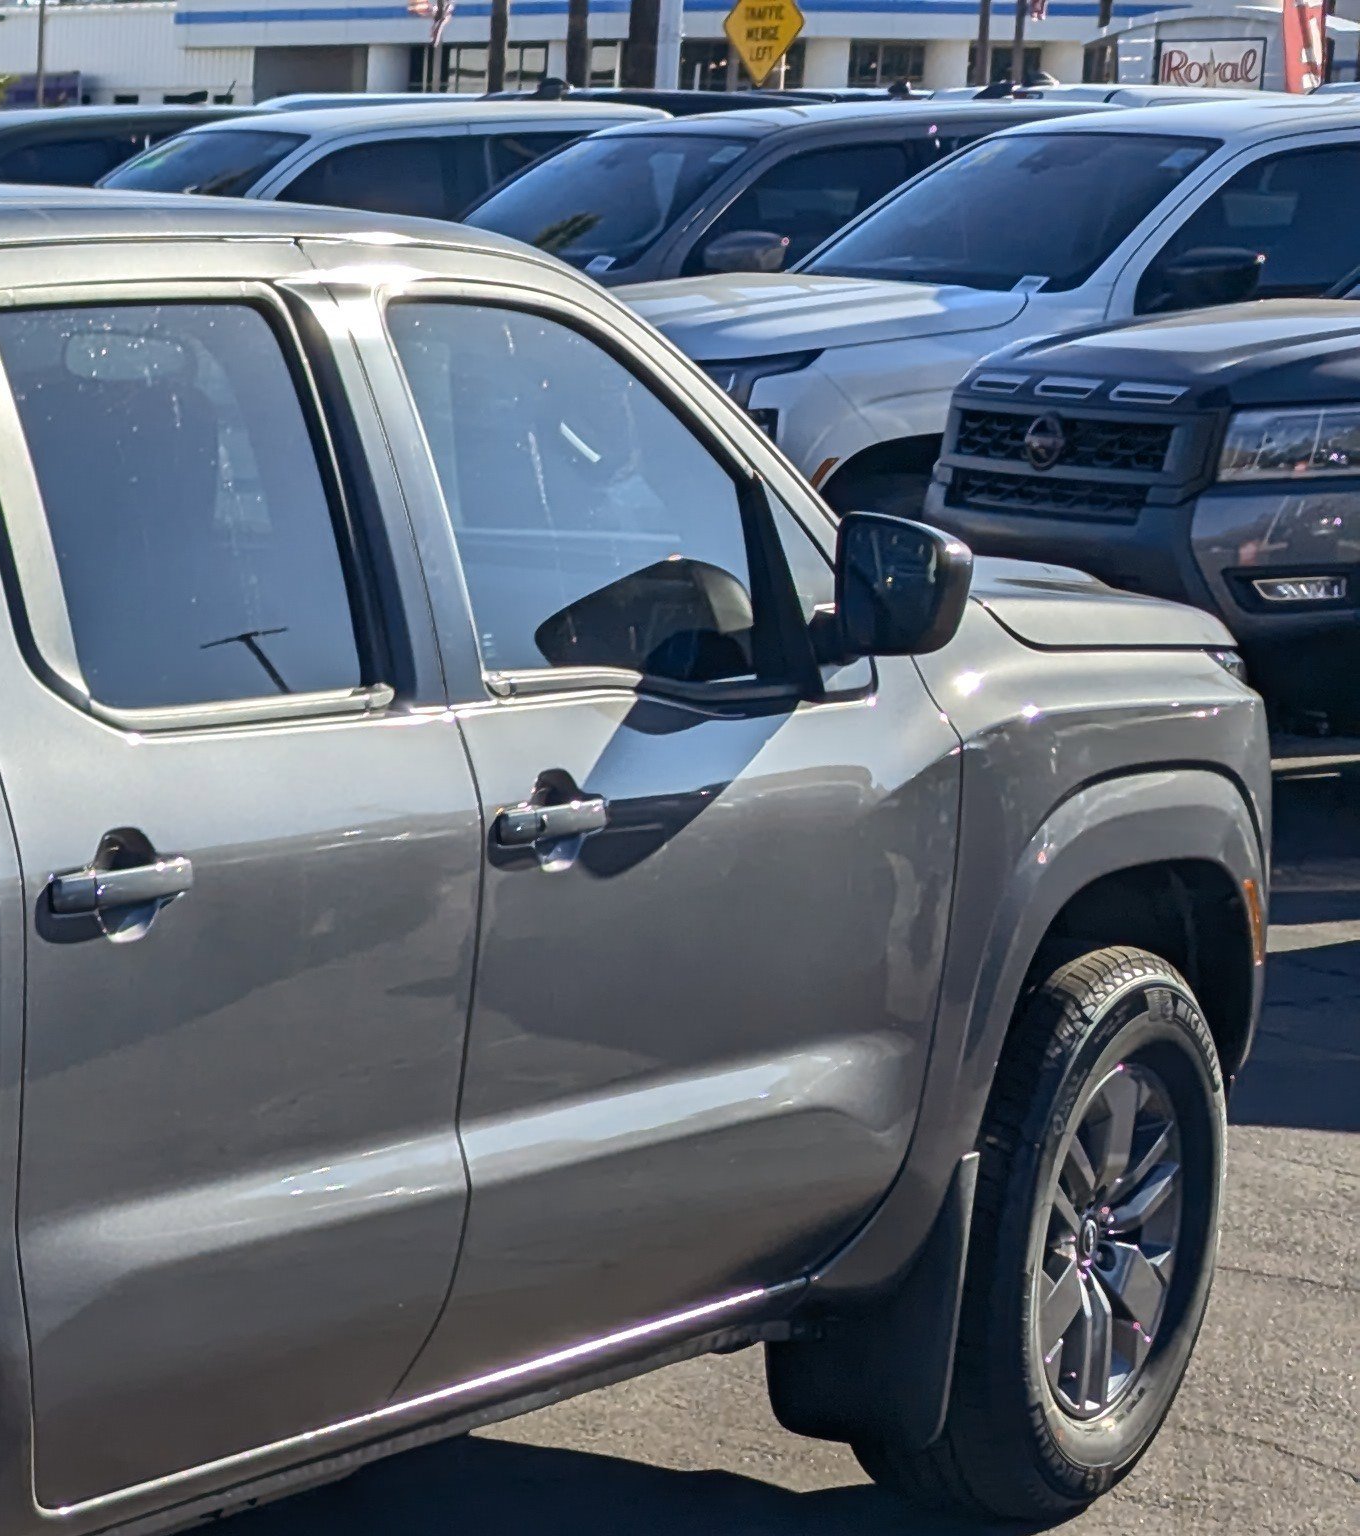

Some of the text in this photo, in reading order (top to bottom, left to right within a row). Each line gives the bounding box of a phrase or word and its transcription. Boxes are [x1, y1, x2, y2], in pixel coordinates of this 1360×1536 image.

[745, 5, 785, 20] TRAFFIC
[745, 25, 780, 41] MERGE
[750, 46, 775, 61] LEFT
